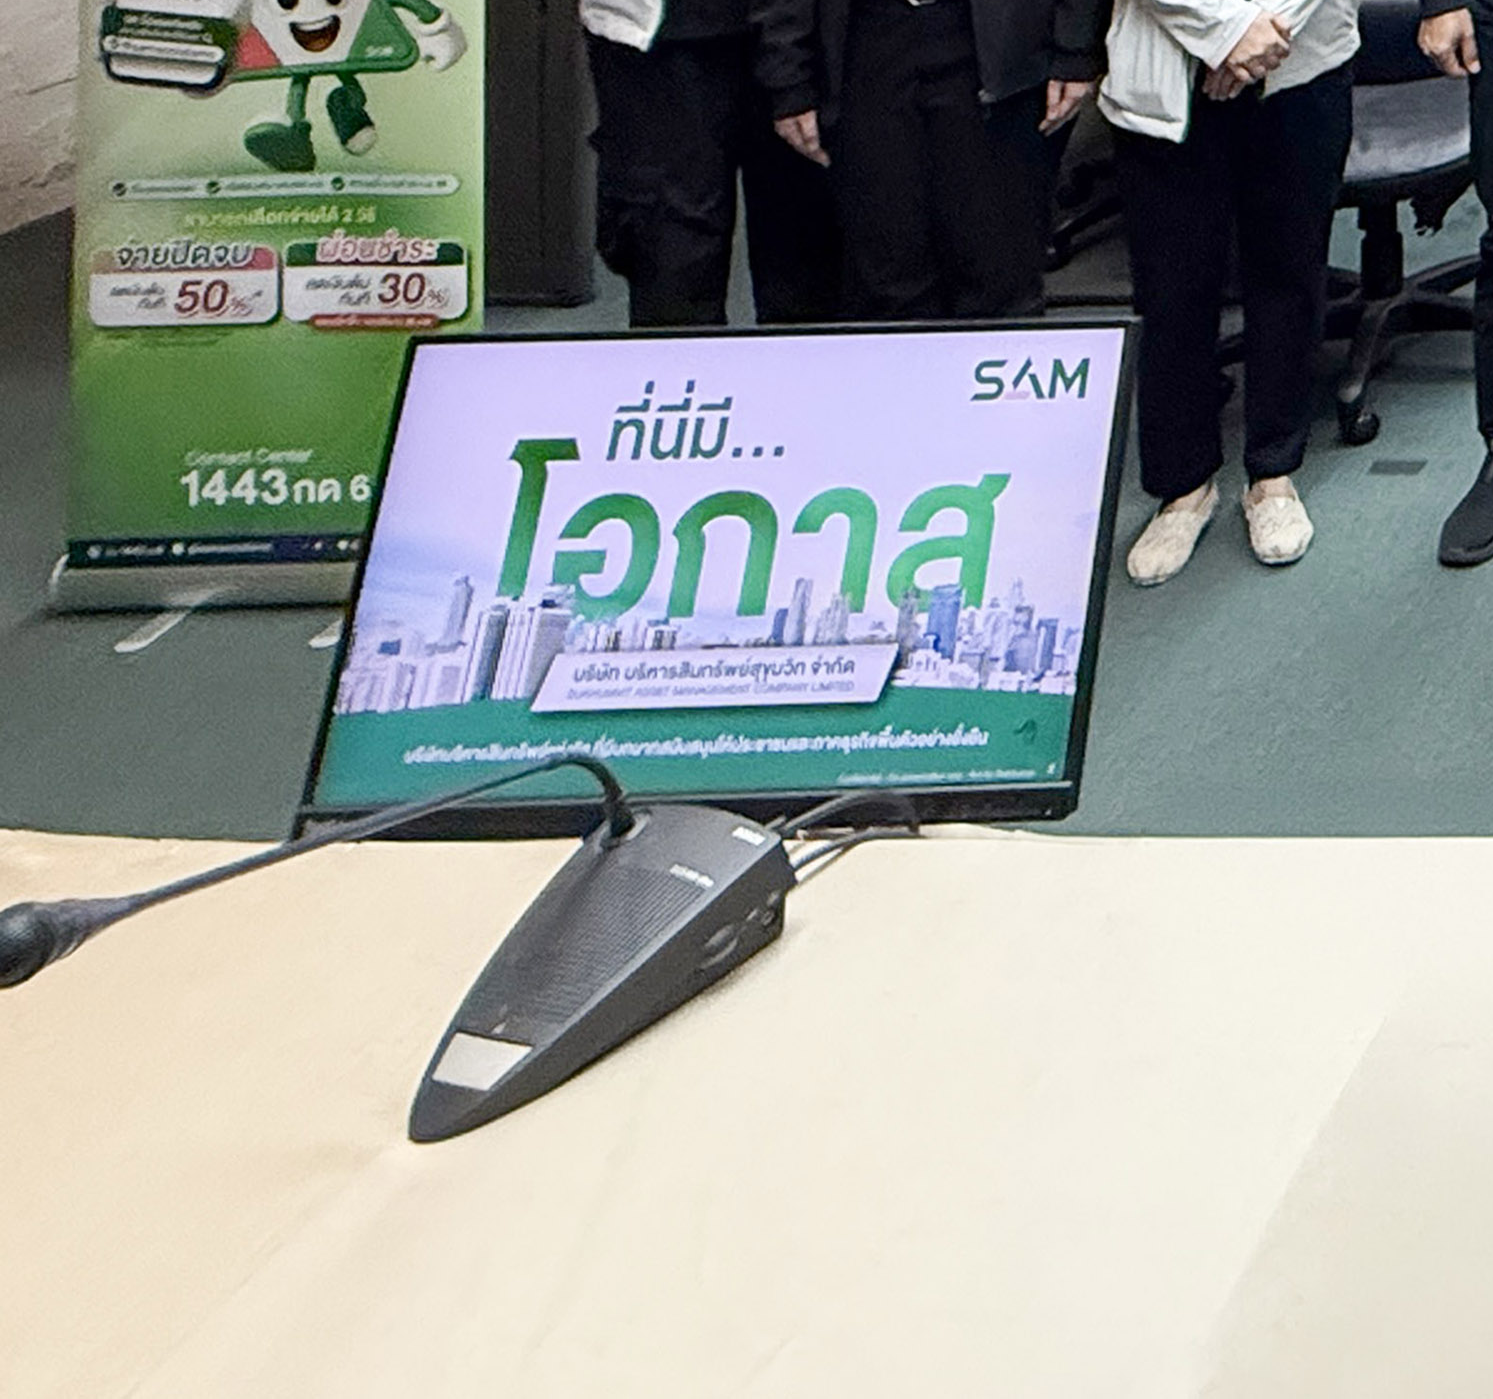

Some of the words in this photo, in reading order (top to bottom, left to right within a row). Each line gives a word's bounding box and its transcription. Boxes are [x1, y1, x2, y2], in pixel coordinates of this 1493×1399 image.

[970, 358, 1092, 402] SAM
[604, 379, 786, 462] ที่นี่มี...
[181, 468, 288, 507] 1443
[293, 477, 342, 504] กด
[349, 473, 372, 502] 6
[498, 437, 1011, 621] โอกาส
